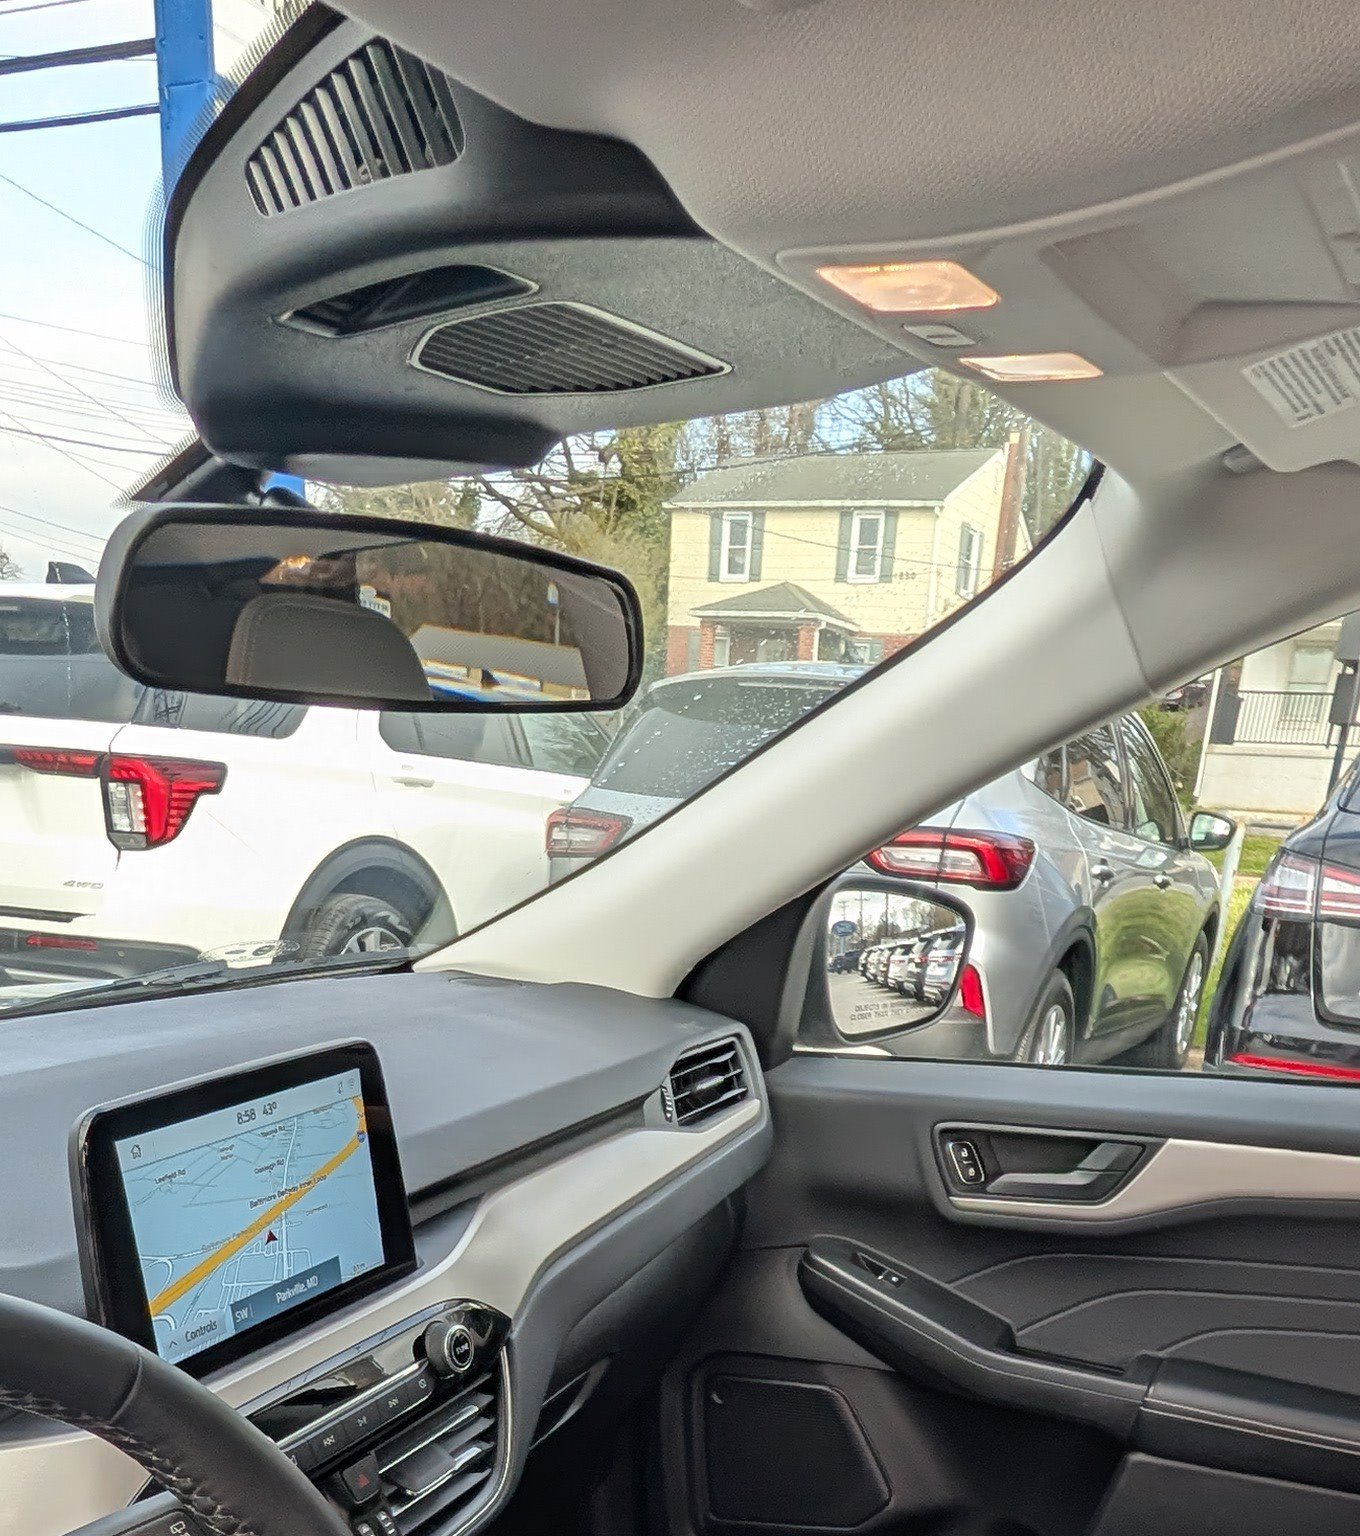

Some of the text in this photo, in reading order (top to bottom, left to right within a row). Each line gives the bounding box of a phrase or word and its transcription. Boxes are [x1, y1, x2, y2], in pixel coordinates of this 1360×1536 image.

[236, 1107, 257, 1125] 8:58
[235, 1306, 249, 1323] SW
[185, 1319, 218, 1343] Controls
